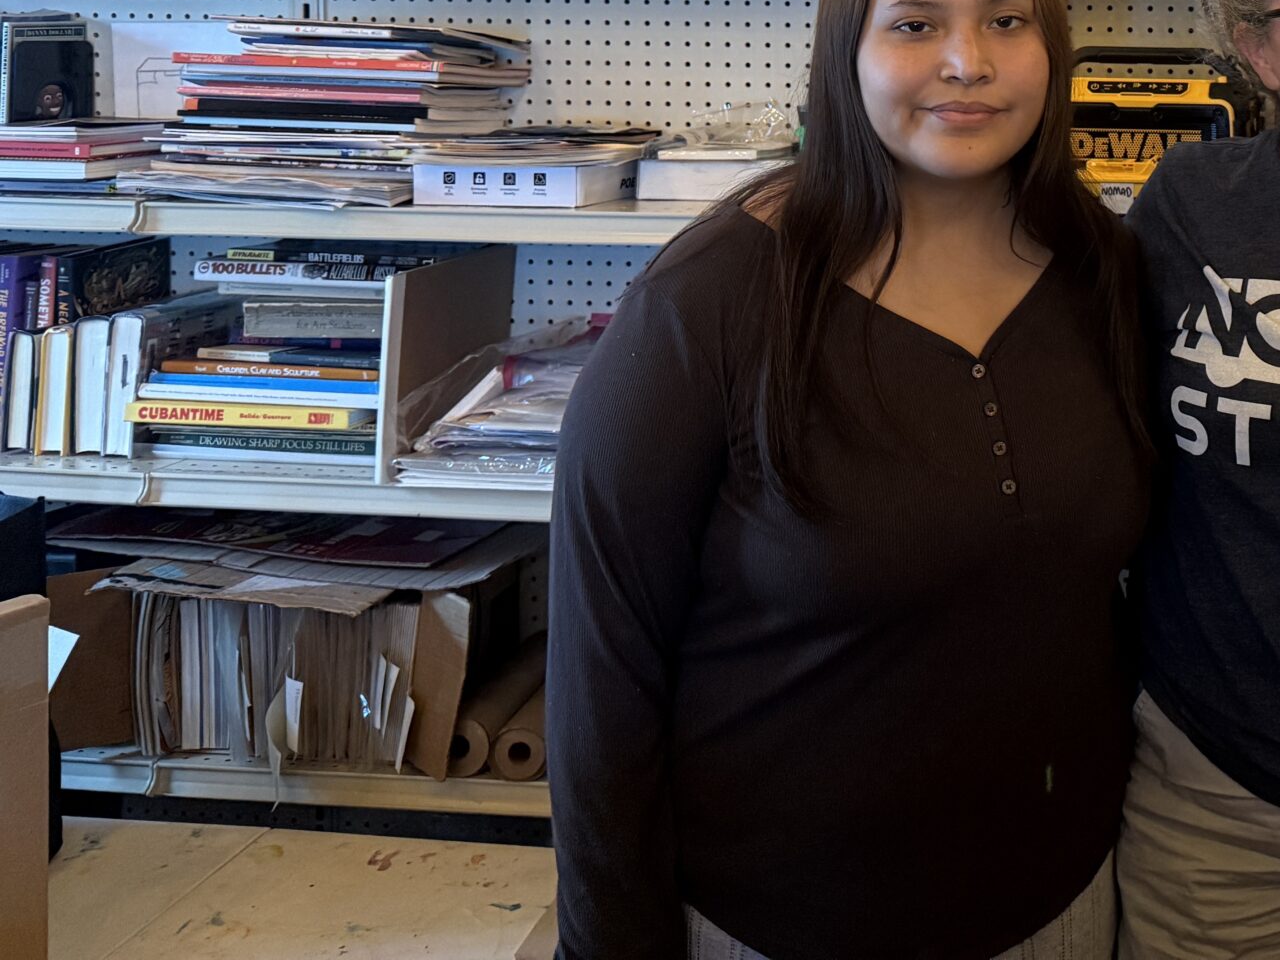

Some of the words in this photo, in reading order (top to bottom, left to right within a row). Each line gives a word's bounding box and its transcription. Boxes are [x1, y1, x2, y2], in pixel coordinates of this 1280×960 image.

[1101, 187, 1132, 197] NOMAD
[308, 253, 364, 263] BATTLEFIELDS
[211, 262, 235, 273] 100
[236, 263, 286, 275] BULLETS
[330, 265, 367, 280] AZZARELLO
[138, 407, 224, 421] CUBANTIME
[200, 436, 248, 446] DRAWING
[249, 437, 281, 447] SHARP
[282, 439, 314, 449] FOCUS
[315, 441, 340, 451] STILL
[341, 442, 365, 452] LIFES
